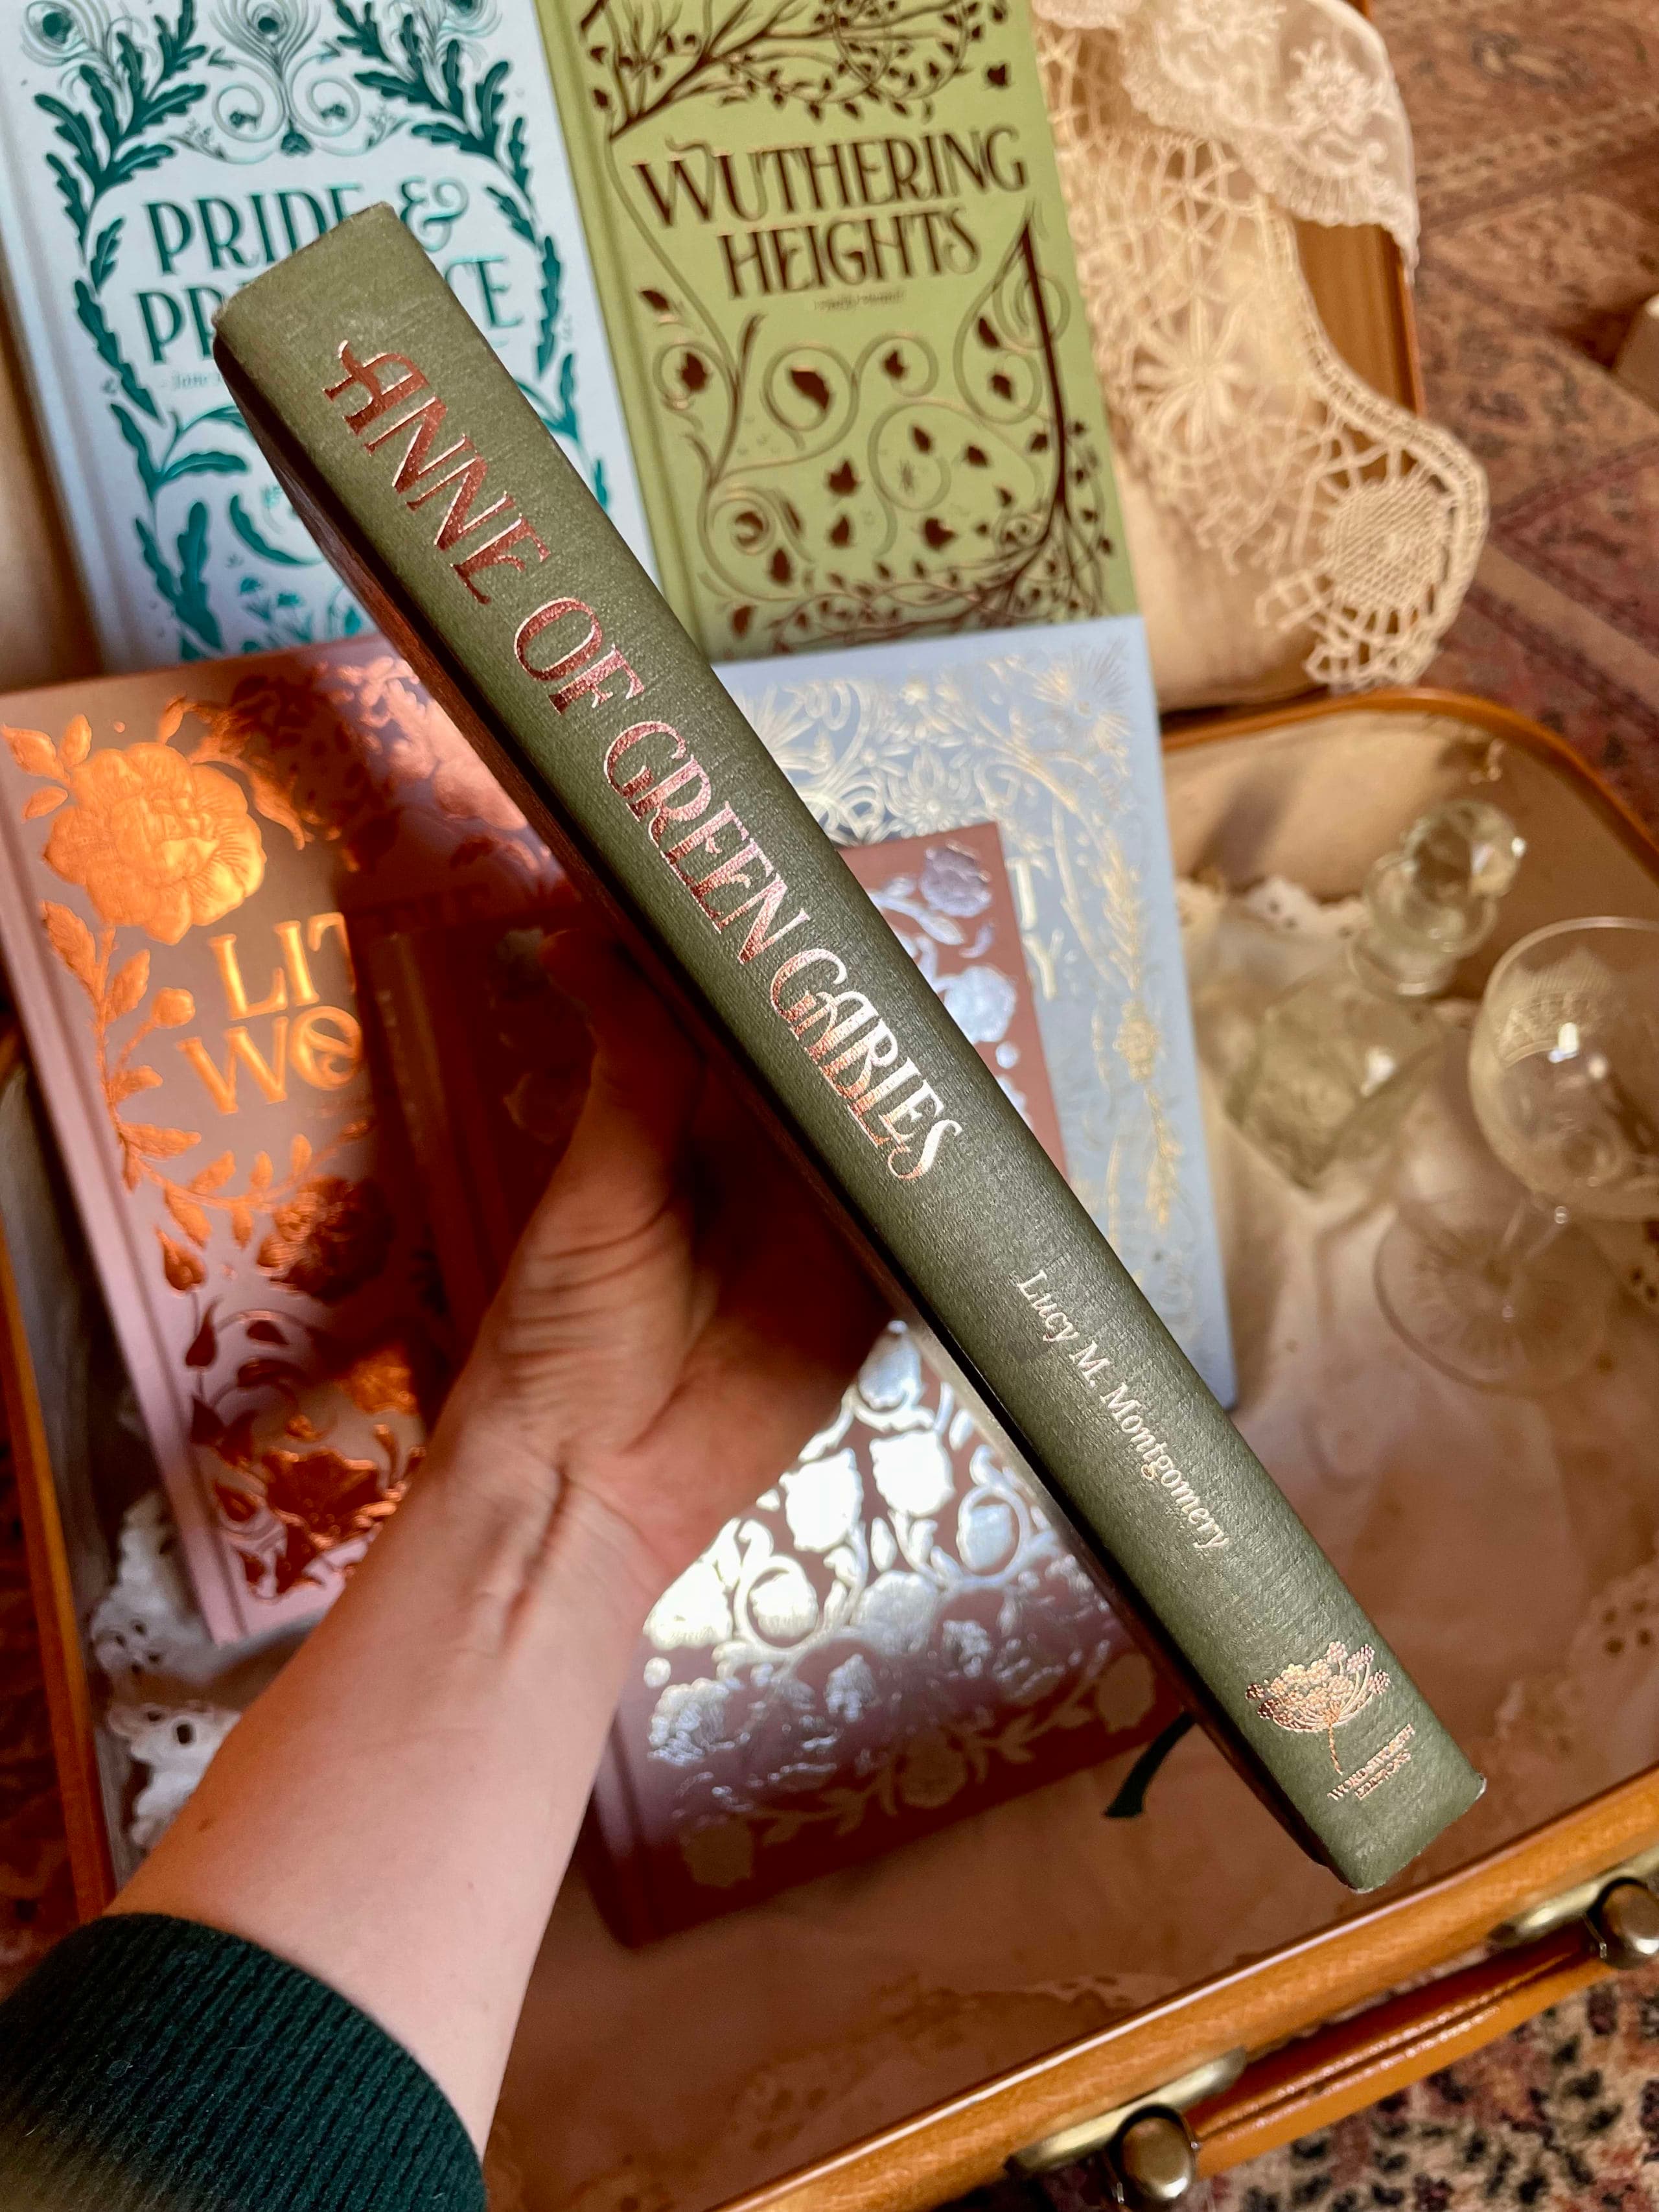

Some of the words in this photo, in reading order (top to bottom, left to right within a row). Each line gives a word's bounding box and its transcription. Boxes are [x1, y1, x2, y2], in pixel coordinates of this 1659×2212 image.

[400, 176, 469, 251] &
[632, 126, 1028, 228] WUTHERING
[717, 206, 982, 300] HEIGHTS
[323, 340, 551, 605] ANNE
[514, 596, 644, 715] OF
[603, 720, 811, 965] GREEN
[770, 948, 964, 1182] GABLES
[1016, 1270, 1080, 1342] Lucy
[1069, 1342, 1110, 1387] M.
[1100, 1382, 1229, 1550] Montgomery
